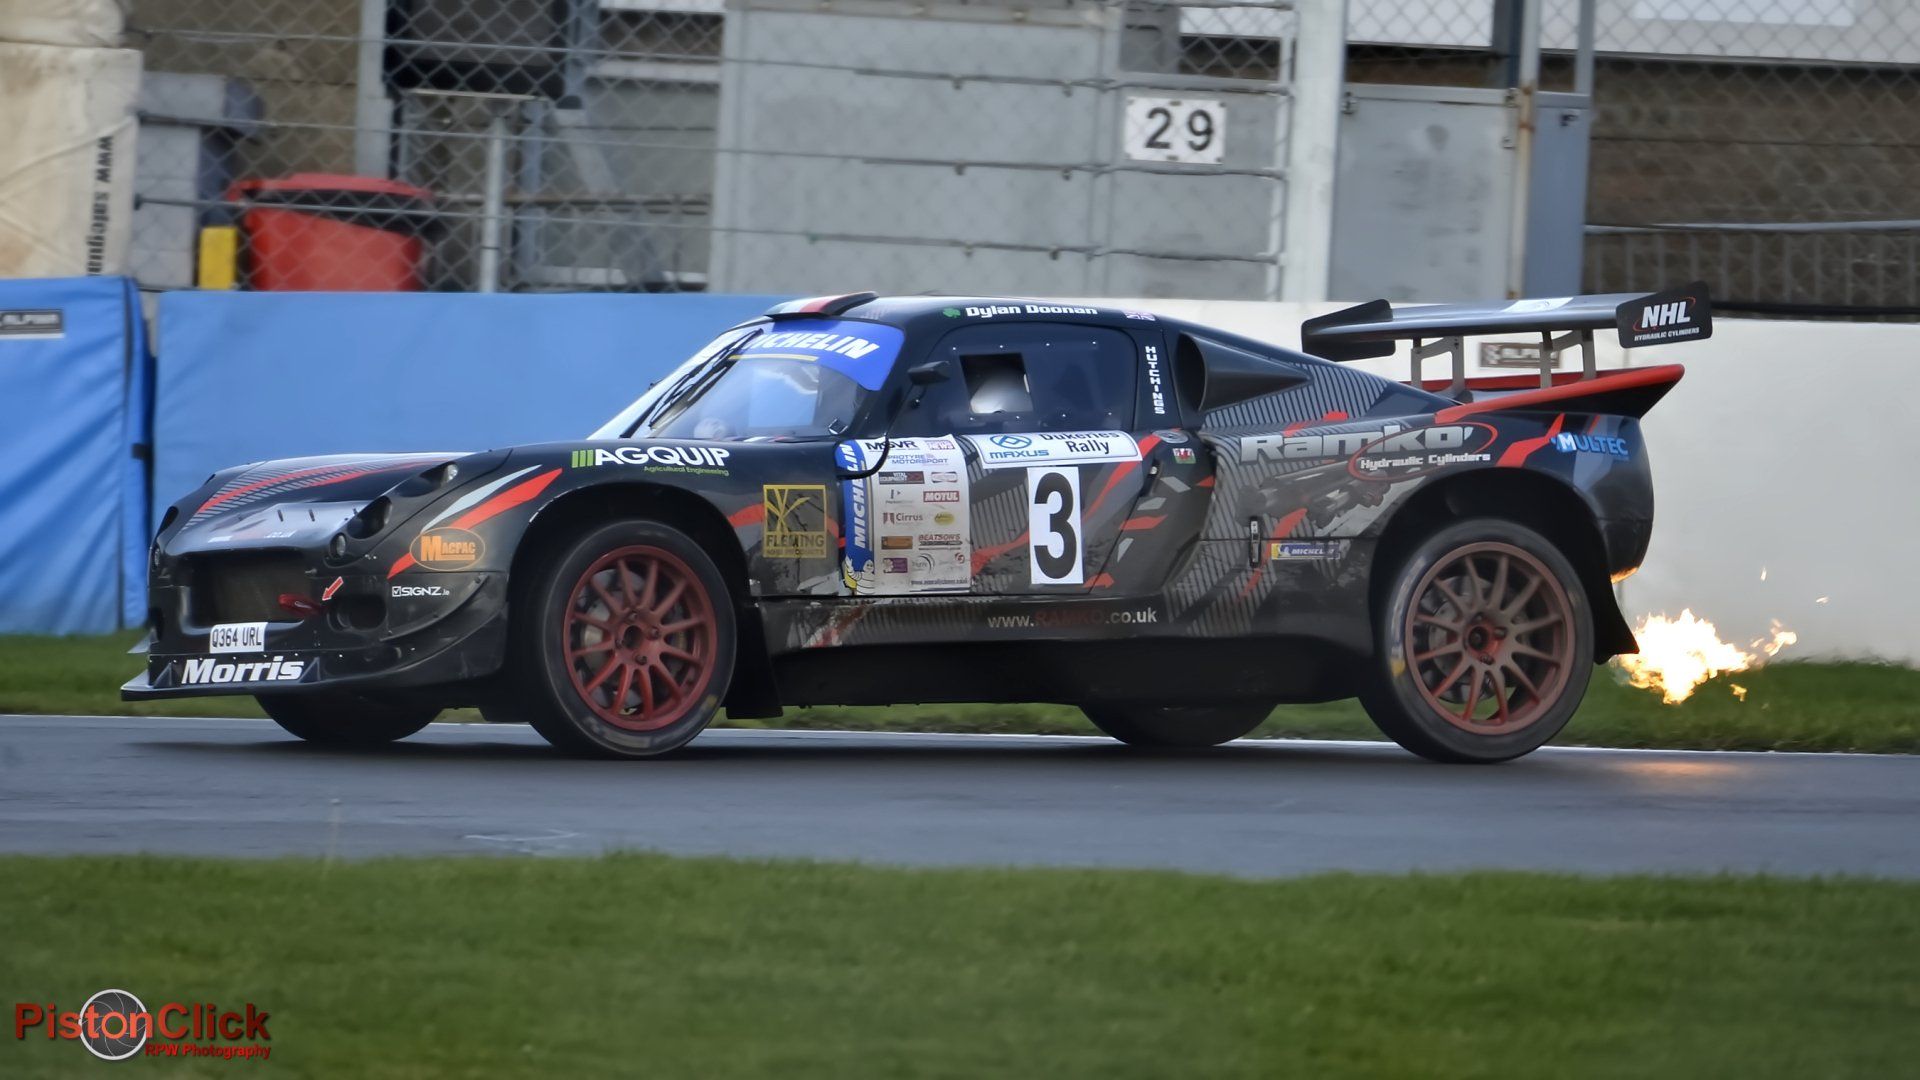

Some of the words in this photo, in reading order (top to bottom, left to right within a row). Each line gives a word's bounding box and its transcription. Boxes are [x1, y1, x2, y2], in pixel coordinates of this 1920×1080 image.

[1144, 107, 1214, 151] 29
[965, 305, 1021, 318] Dylan
[1025, 304, 1098, 315] Doonan
[1641, 301, 1691, 328] NHL
[1634, 331, 1667, 341] HYDRAULIC
[1667, 327, 1700, 337] CYLINDERS
[1145, 346, 1165, 415] HUTCHINGS
[1065, 439, 1111, 454] Rally
[1556, 432, 1629, 456] MULTEC
[595, 447, 731, 466] AGQUIP
[989, 449, 1050, 459] MAXUS
[1360, 455, 1424, 471] Hydraulic
[1428, 452, 1491, 466] Cylinders
[643, 465, 686, 473] Agricultural
[686, 466, 730, 476] Engineering
[924, 492, 958, 501] MOTUL
[896, 512, 923, 521] Cirrus
[1033, 471, 1078, 579] 3
[766, 534, 825, 547] FLEMING
[211, 628, 238, 648] Q364
[242, 627, 262, 646] URL
[181, 655, 304, 684] Morris
